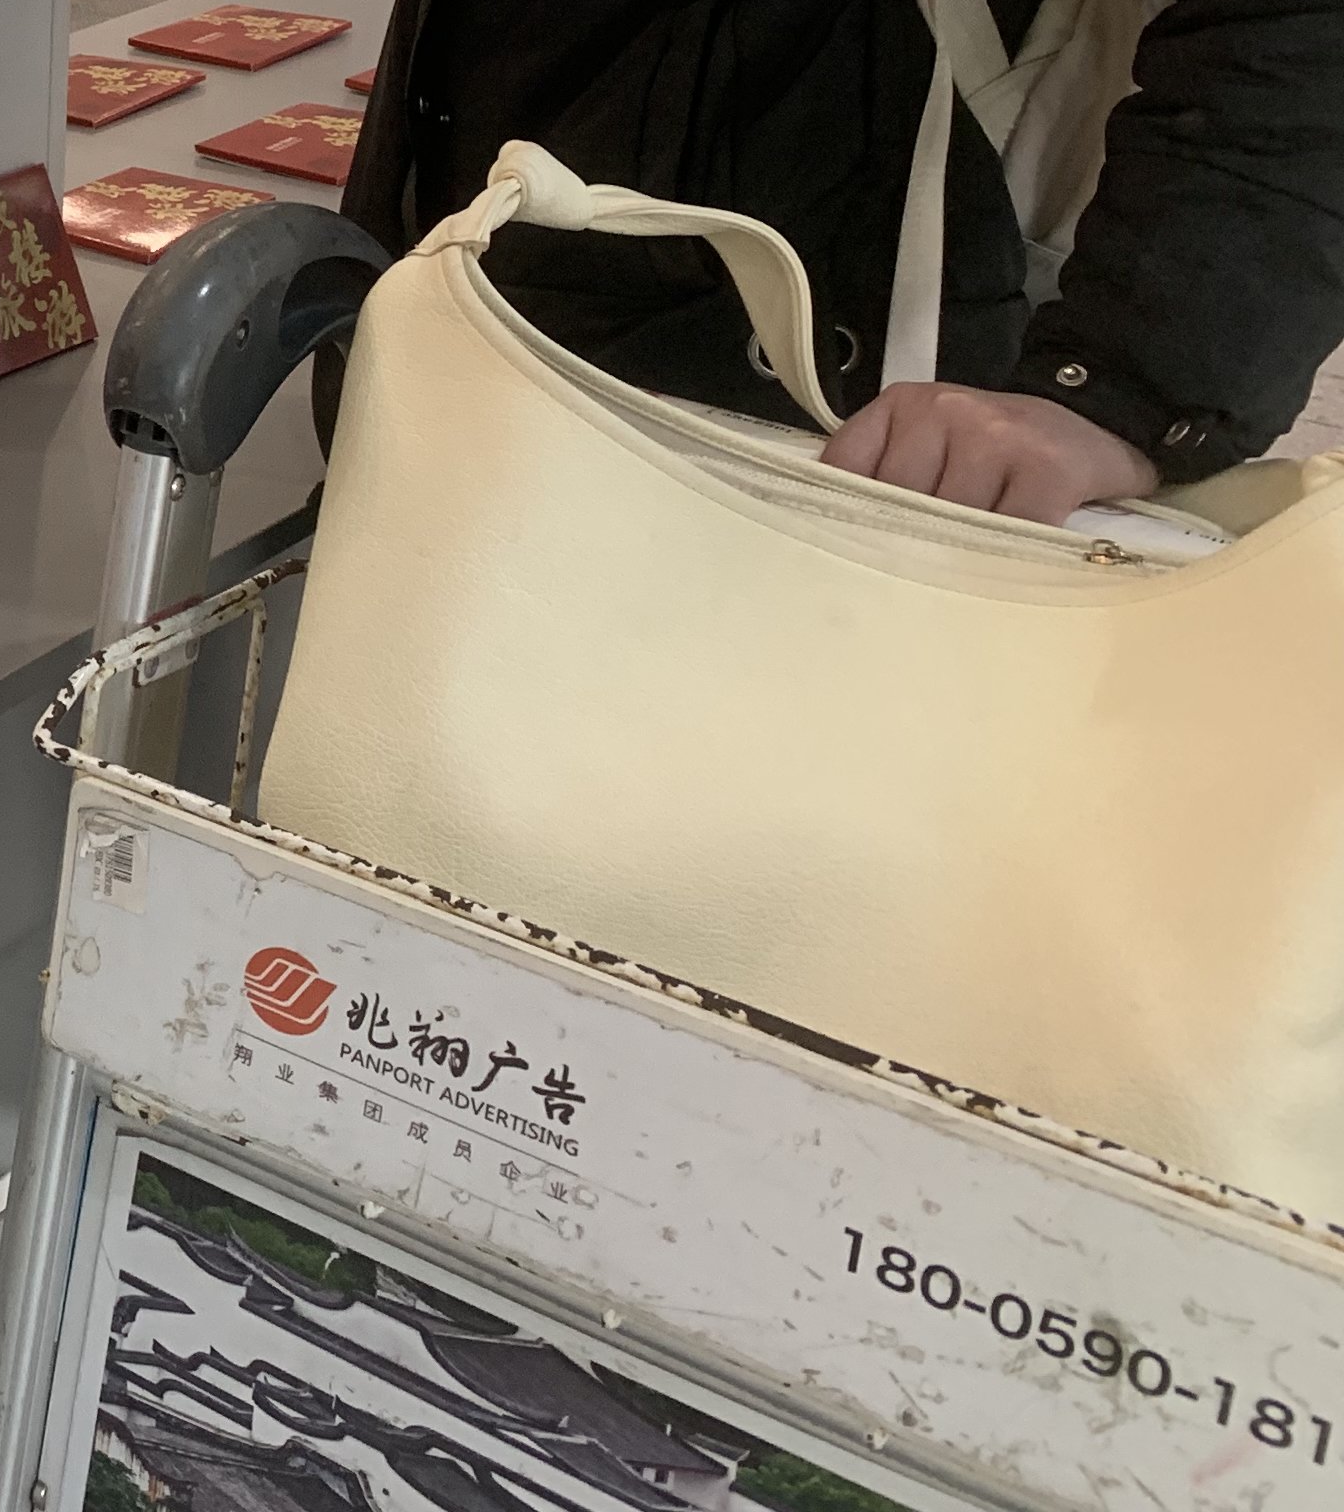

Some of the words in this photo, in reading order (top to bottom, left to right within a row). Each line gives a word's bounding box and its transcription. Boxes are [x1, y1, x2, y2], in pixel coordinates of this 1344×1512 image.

[233, 1042, 570, 1204] 翔业集团成员企业
[338, 1041, 436, 1096] PANPORT
[438, 1085, 580, 1158] ADVERTISING
[345, 991, 587, 1126] 兆翔广告
[842, 1226, 1333, 1467] 180-0590-181
